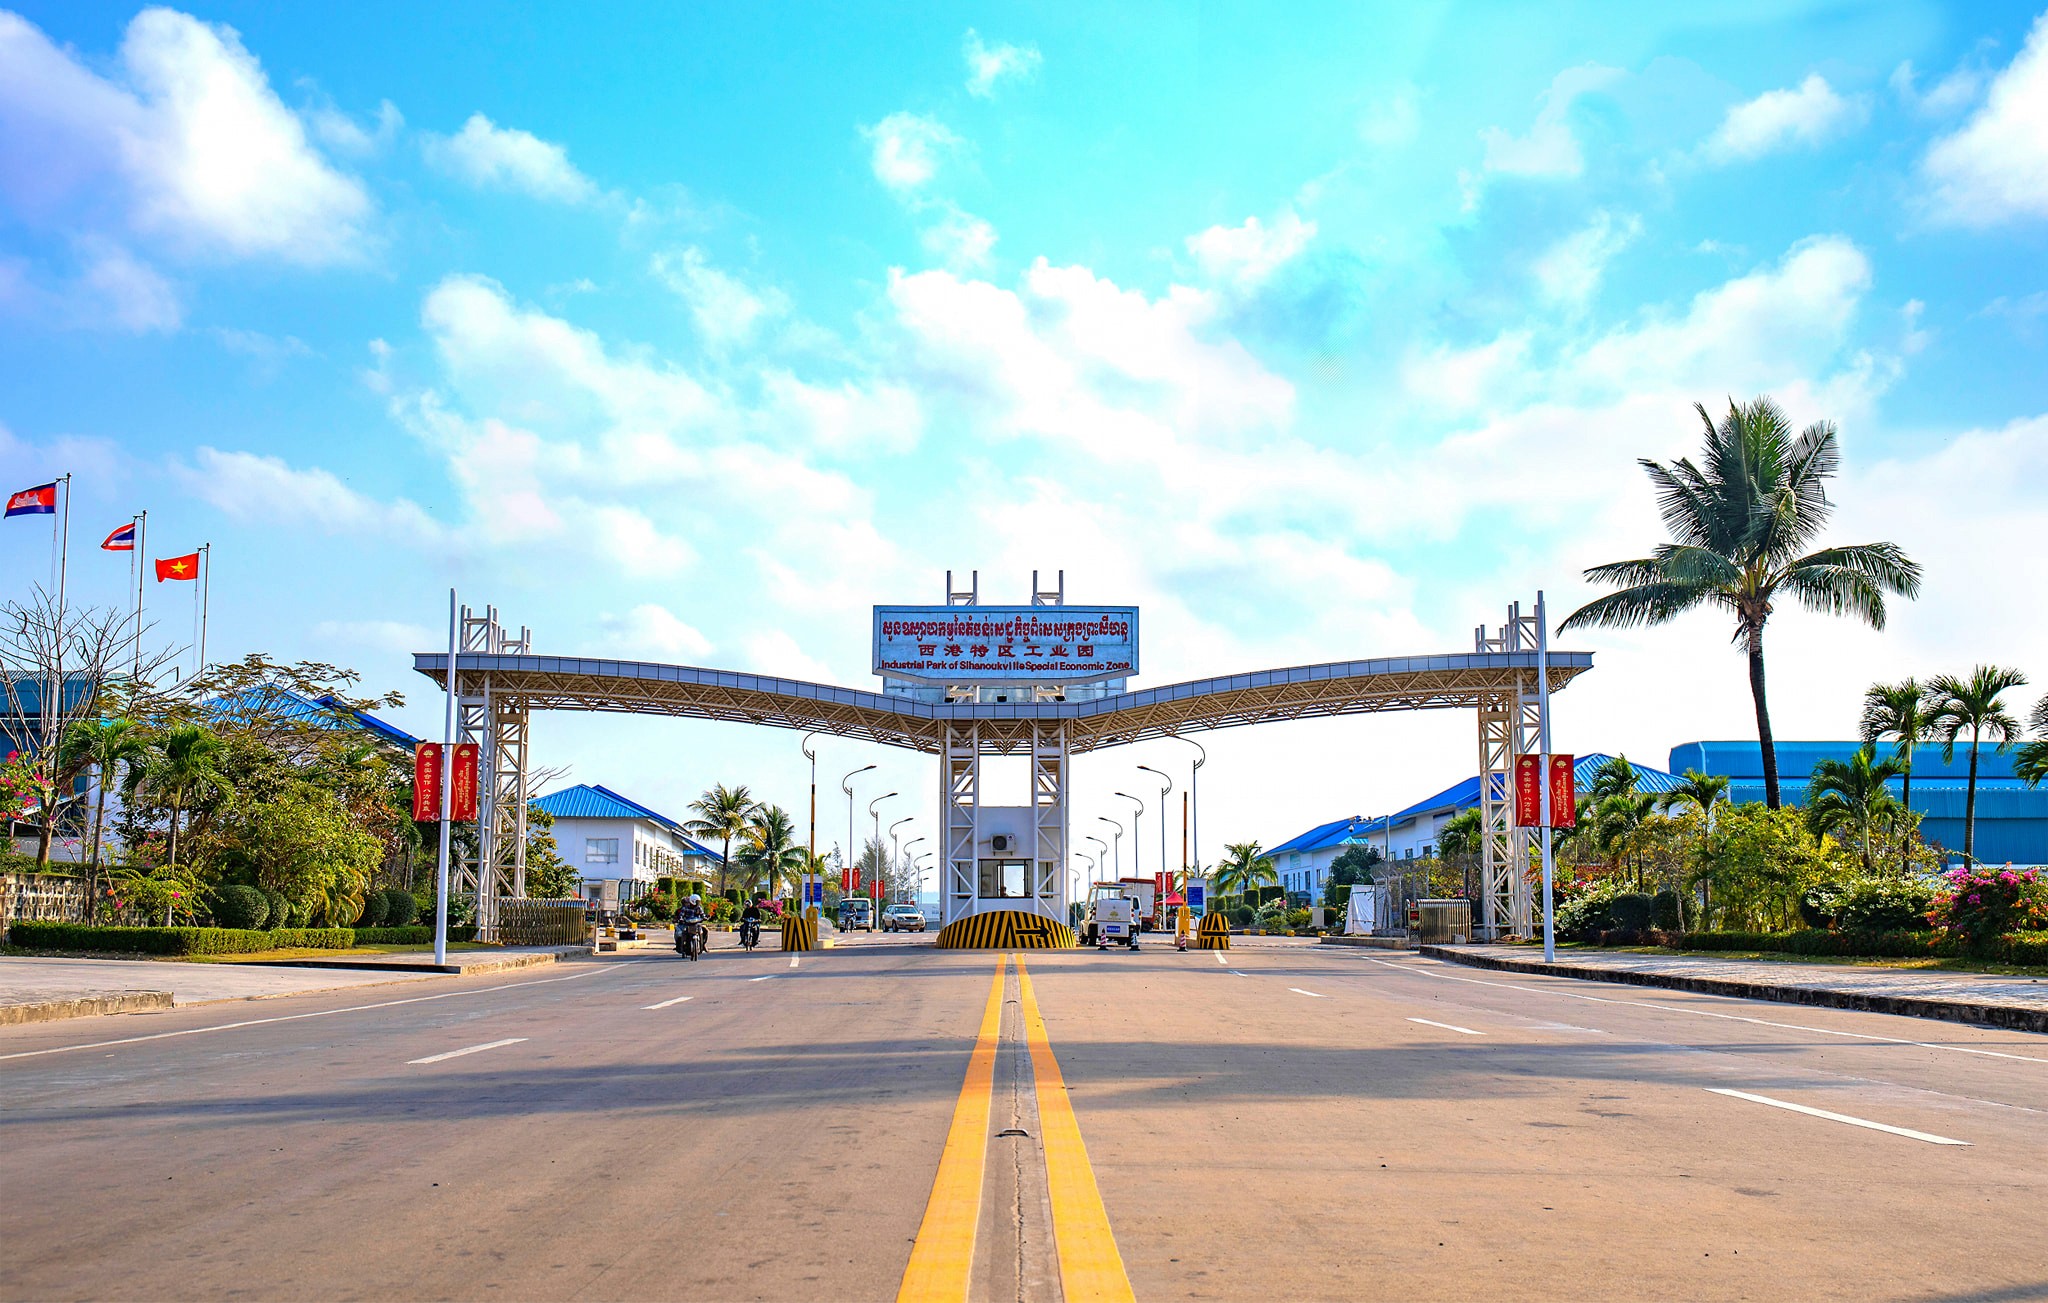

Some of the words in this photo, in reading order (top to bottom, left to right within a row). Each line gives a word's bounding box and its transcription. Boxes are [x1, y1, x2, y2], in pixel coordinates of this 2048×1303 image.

[918, 644, 1094, 657] 西港特区工业园
[882, 660, 925, 669] Industrial
[926, 661, 947, 669] Park
[948, 660, 958, 669] of
[959, 661, 1025, 670] Sihanoukville
[1025, 661, 1058, 672] Special
[1060, 662, 1105, 670] Economic
[1106, 661, 1130, 670] Zone
